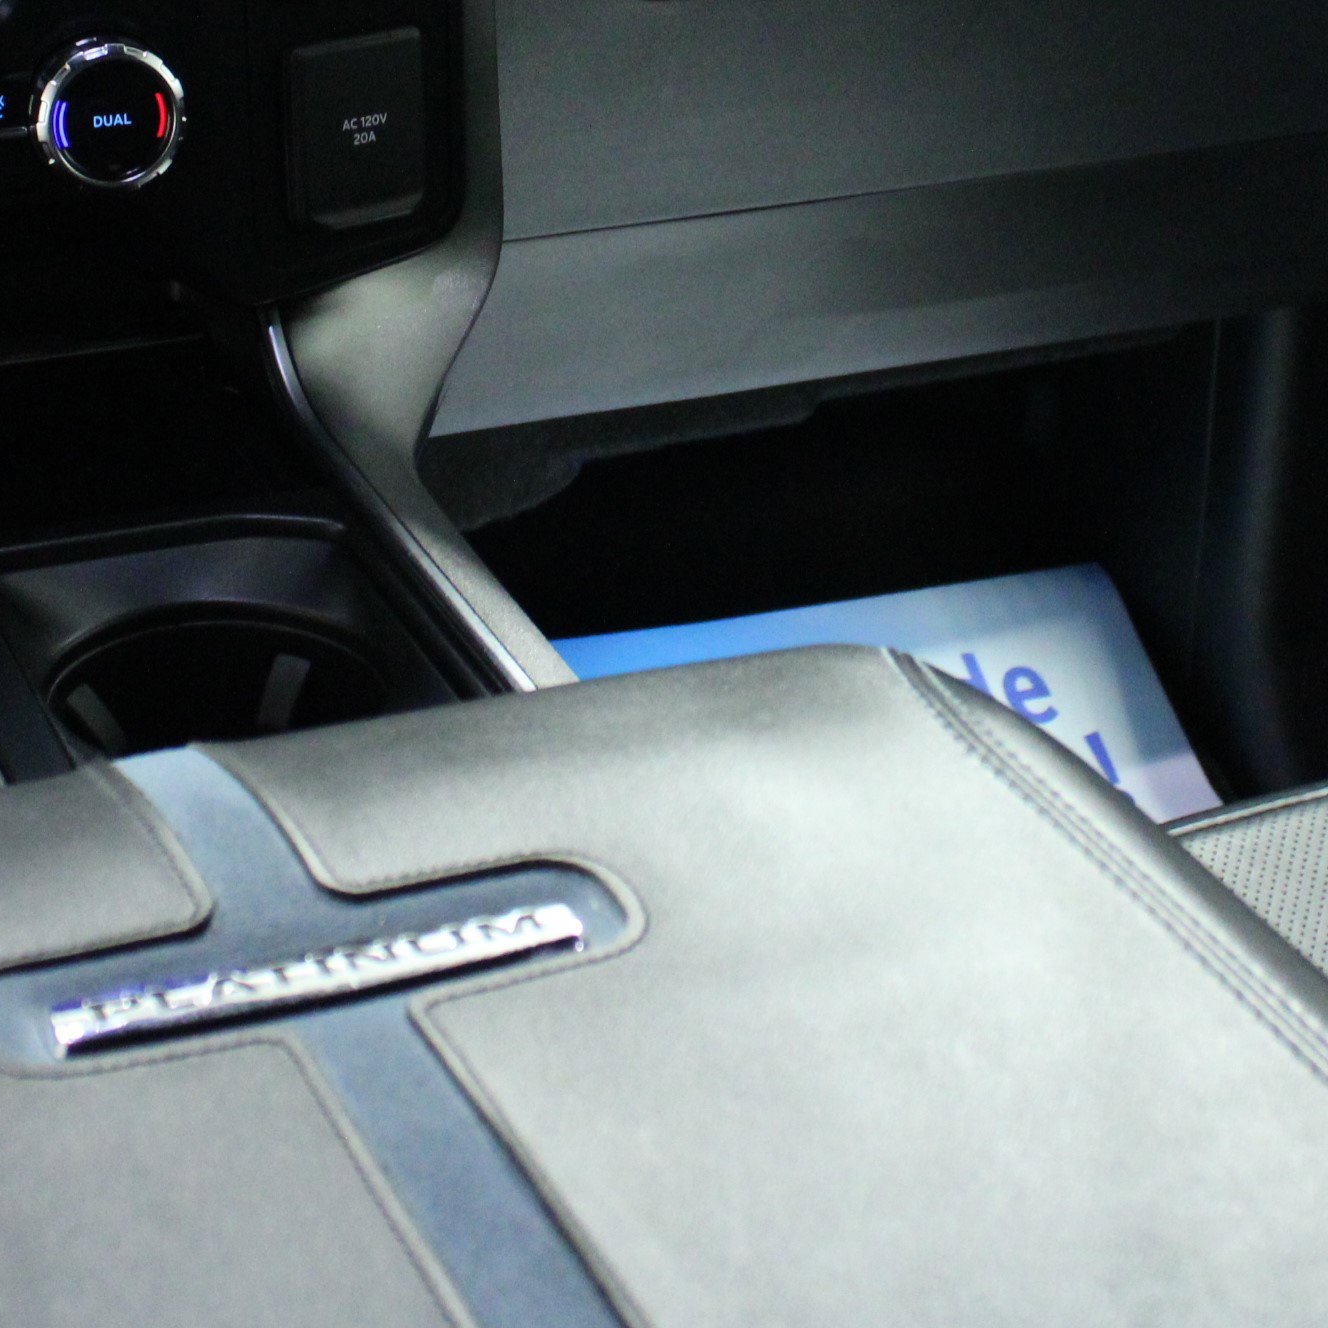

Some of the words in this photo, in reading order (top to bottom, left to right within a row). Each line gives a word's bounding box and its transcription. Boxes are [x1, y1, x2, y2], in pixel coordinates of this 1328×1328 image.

[92, 113, 132, 128] DUAL
[342, 117, 359, 131] AC
[361, 112, 387, 128] 120V
[353, 131, 377, 145] 20A
